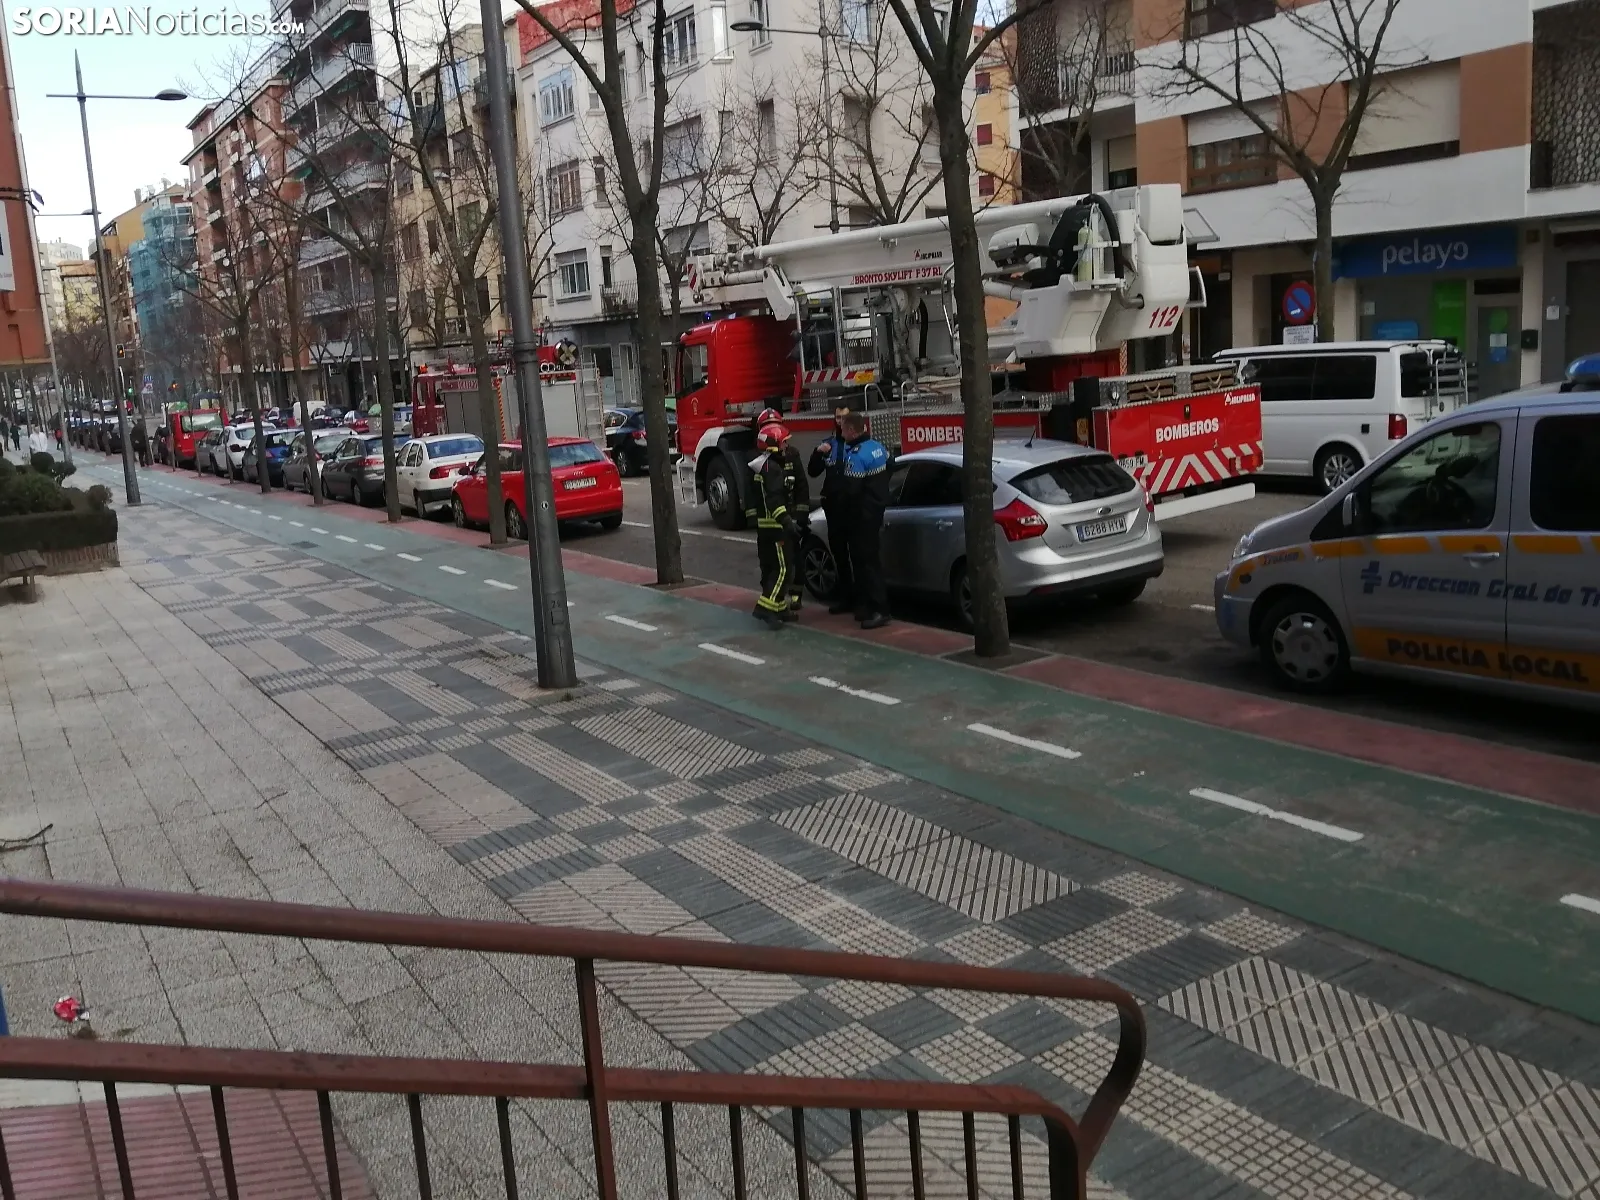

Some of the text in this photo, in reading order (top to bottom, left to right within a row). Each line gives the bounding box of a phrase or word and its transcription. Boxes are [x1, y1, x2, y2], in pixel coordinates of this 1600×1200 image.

[1382, 238, 1469, 273] pelayo
[854, 273, 884, 285] BRONTO
[884, 269, 912, 282] SKYLIFT
[1149, 305, 1179, 330] 112
[907, 426, 964, 442] BOMBER
[1155, 417, 1220, 443] BOMBEROS
[1543, 584, 1573, 605] de
[1497, 651, 1590, 684] LOCAL
